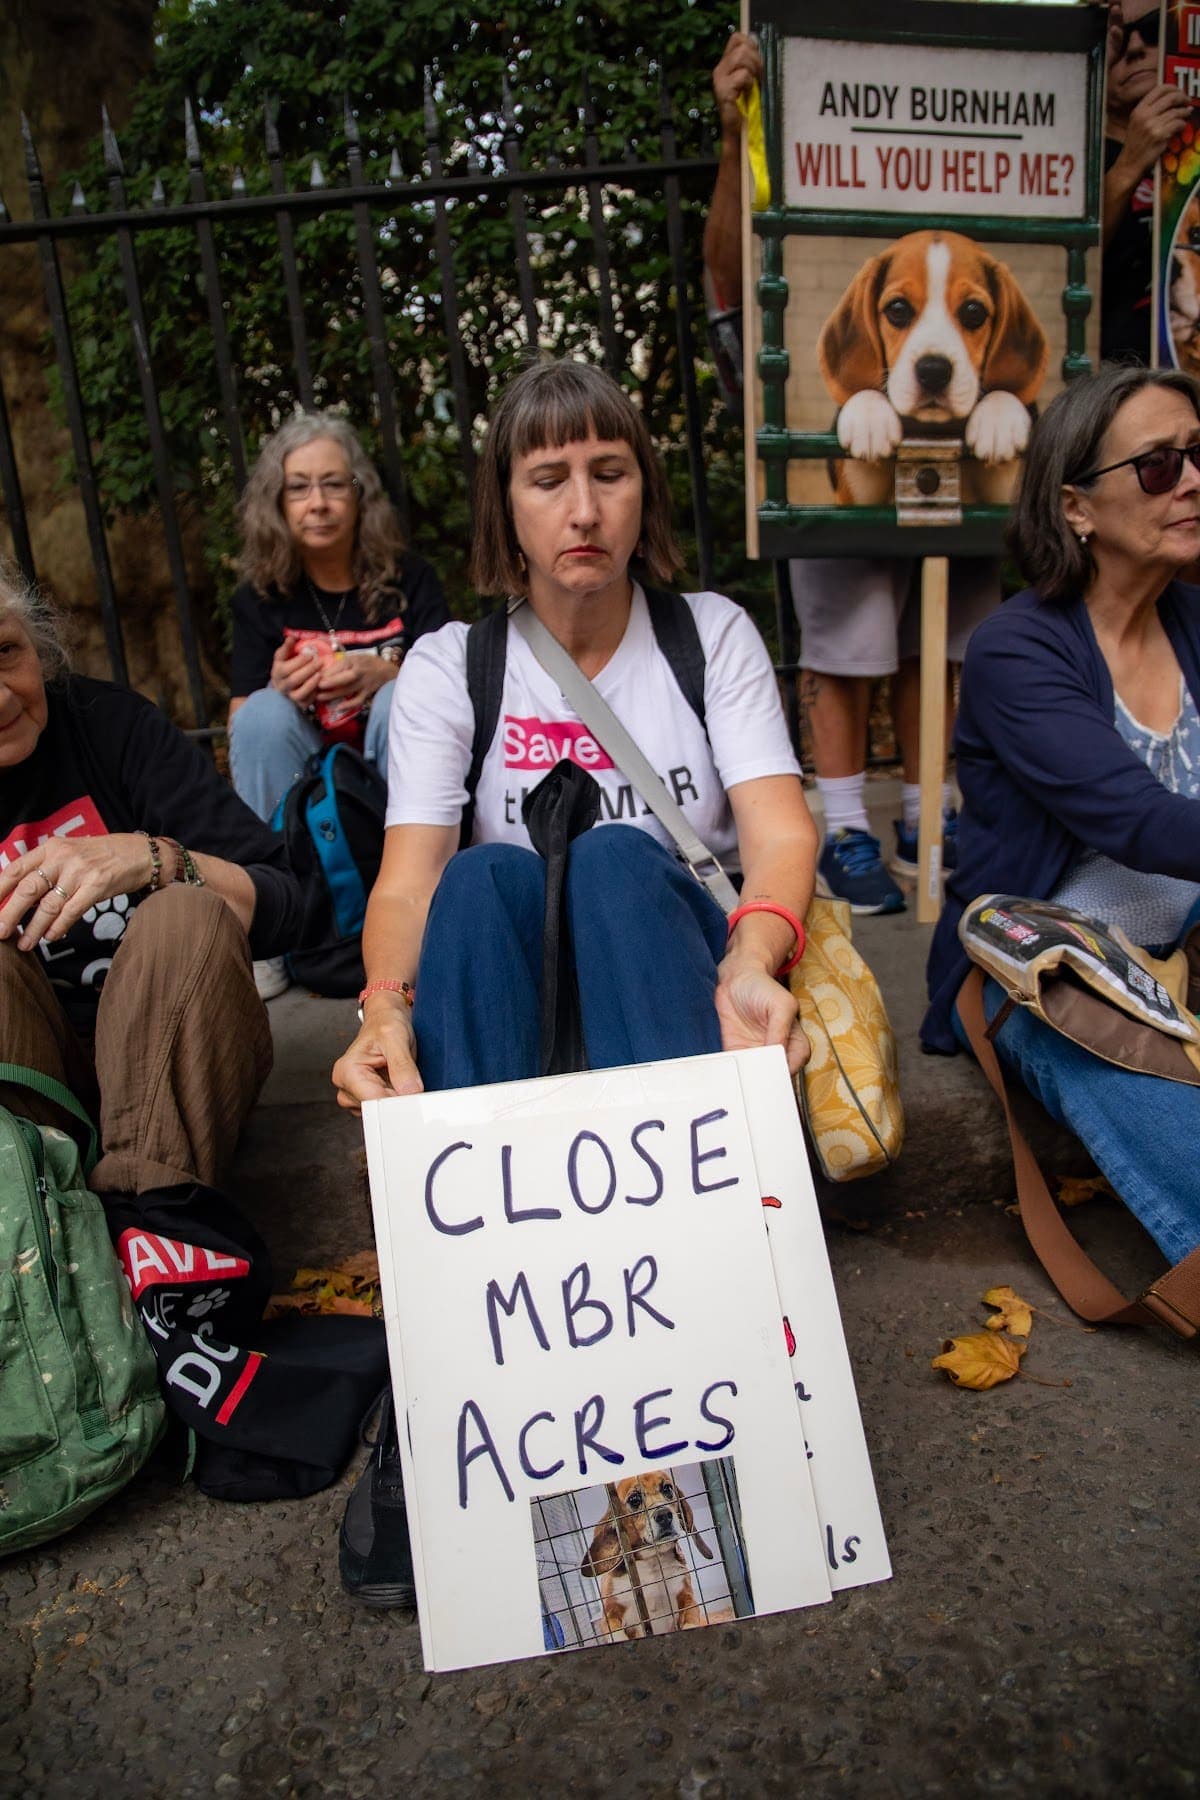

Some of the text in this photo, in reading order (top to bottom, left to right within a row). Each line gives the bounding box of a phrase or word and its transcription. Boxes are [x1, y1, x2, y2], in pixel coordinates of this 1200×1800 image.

[819, 81, 1056, 127] ANDY BURNHAM
[795, 142, 1075, 196] WILL YOU HELP ME?
[504, 721, 600, 765] Save
[597, 765, 699, 821] MR
[424, 1107, 739, 1236] CLOSE
[485, 1254, 675, 1366] MBR
[456, 1381, 738, 1510] ACRES
